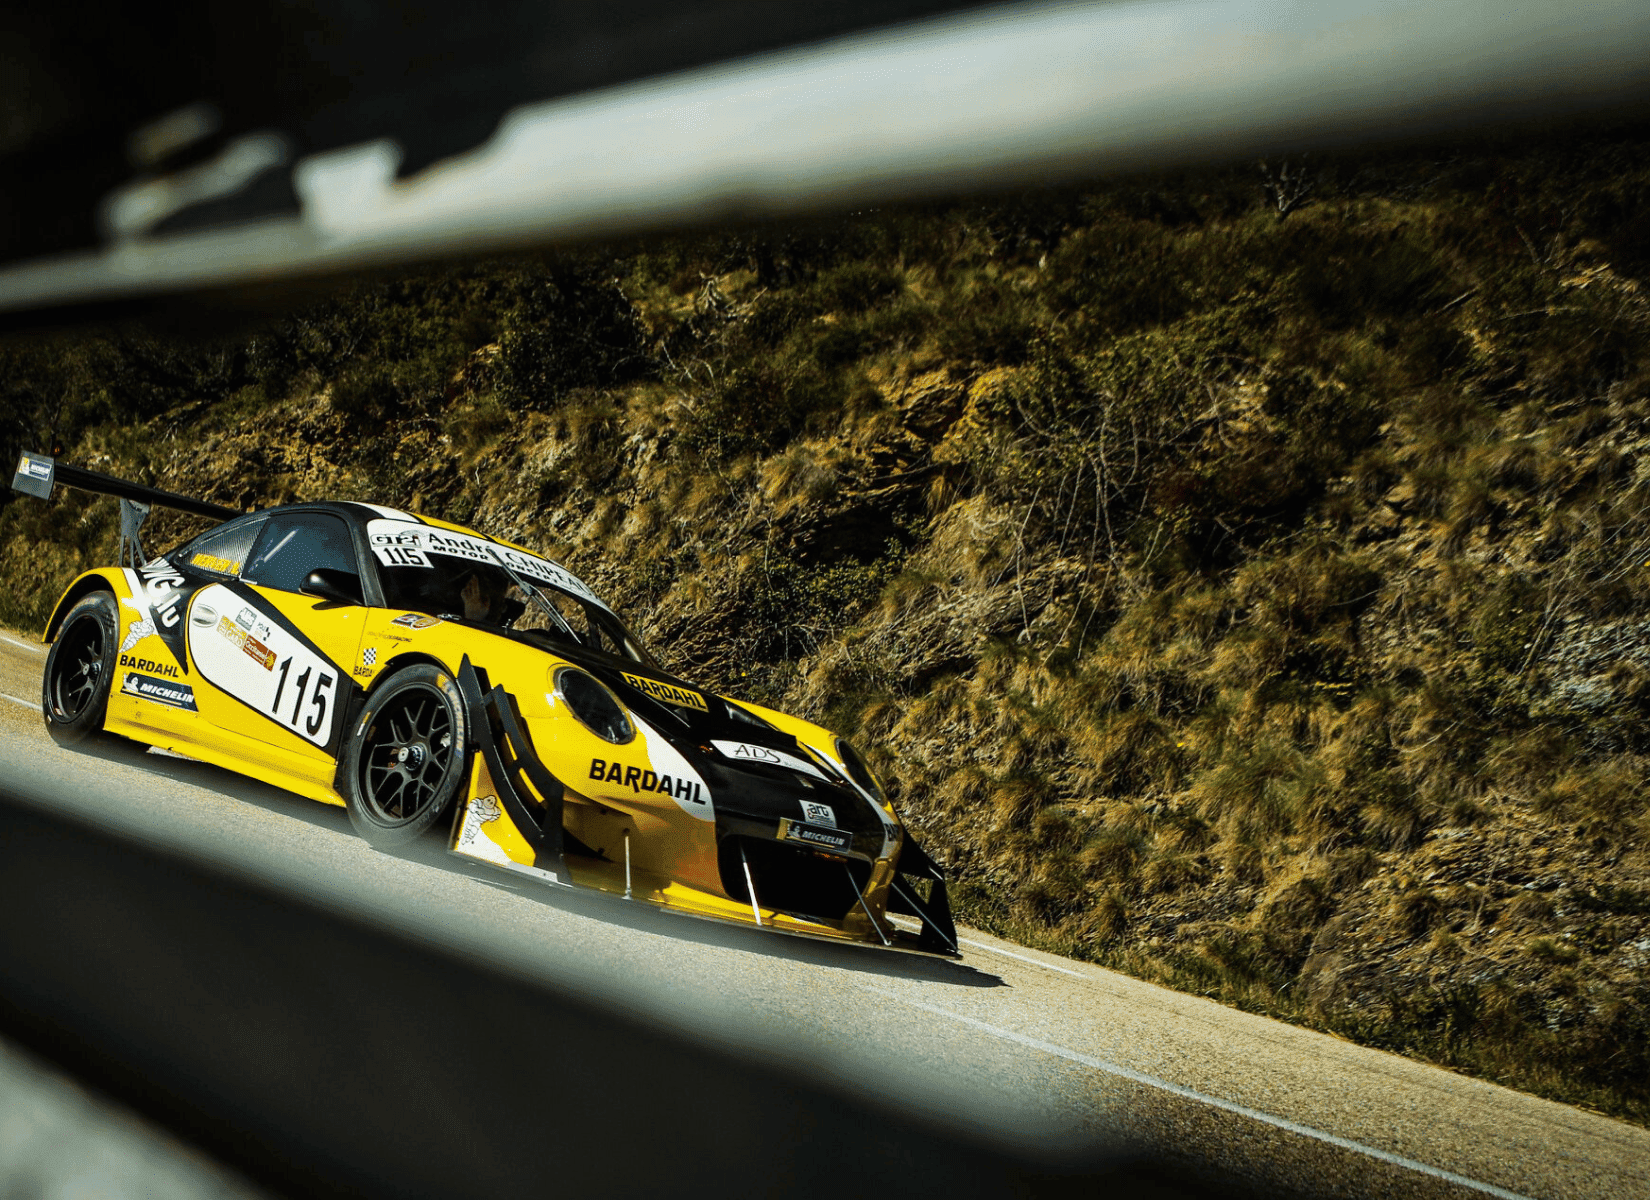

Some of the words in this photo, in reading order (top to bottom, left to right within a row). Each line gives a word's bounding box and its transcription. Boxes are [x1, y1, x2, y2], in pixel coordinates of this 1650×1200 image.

[383, 548, 424, 565] 115
[433, 545, 489, 560] MOTOR
[505, 562, 558, 584] ONCEPT
[120, 655, 179, 678] BARDAHL
[140, 683, 194, 703] MICHELIN
[272, 656, 333, 736] 115
[626, 675, 707, 709] BARDAHL
[734, 744, 781, 763] ADS
[589, 758, 706, 805] BARDAHL
[802, 830, 845, 846] MICHELIN
